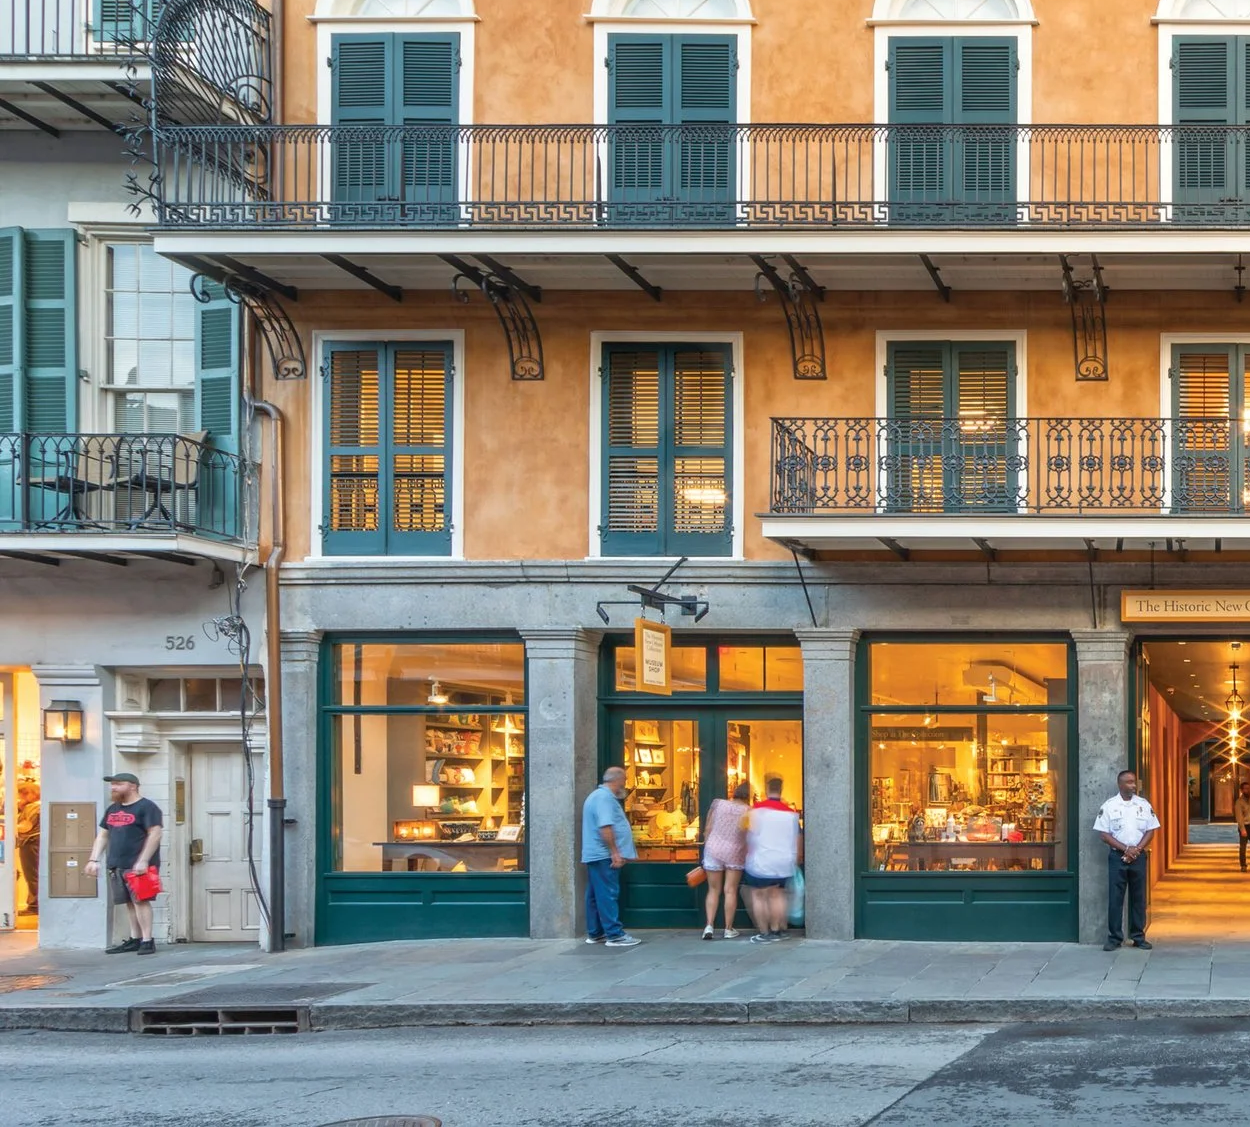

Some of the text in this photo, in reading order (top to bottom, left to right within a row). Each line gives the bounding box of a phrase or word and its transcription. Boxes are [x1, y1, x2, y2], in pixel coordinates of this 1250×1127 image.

[1135, 600, 1160, 612] The
[1164, 600, 1211, 612] Historic
[1215, 600, 1243, 612] New
[165, 634, 195, 650] 526
[645, 658, 663, 667] MUSEUM
